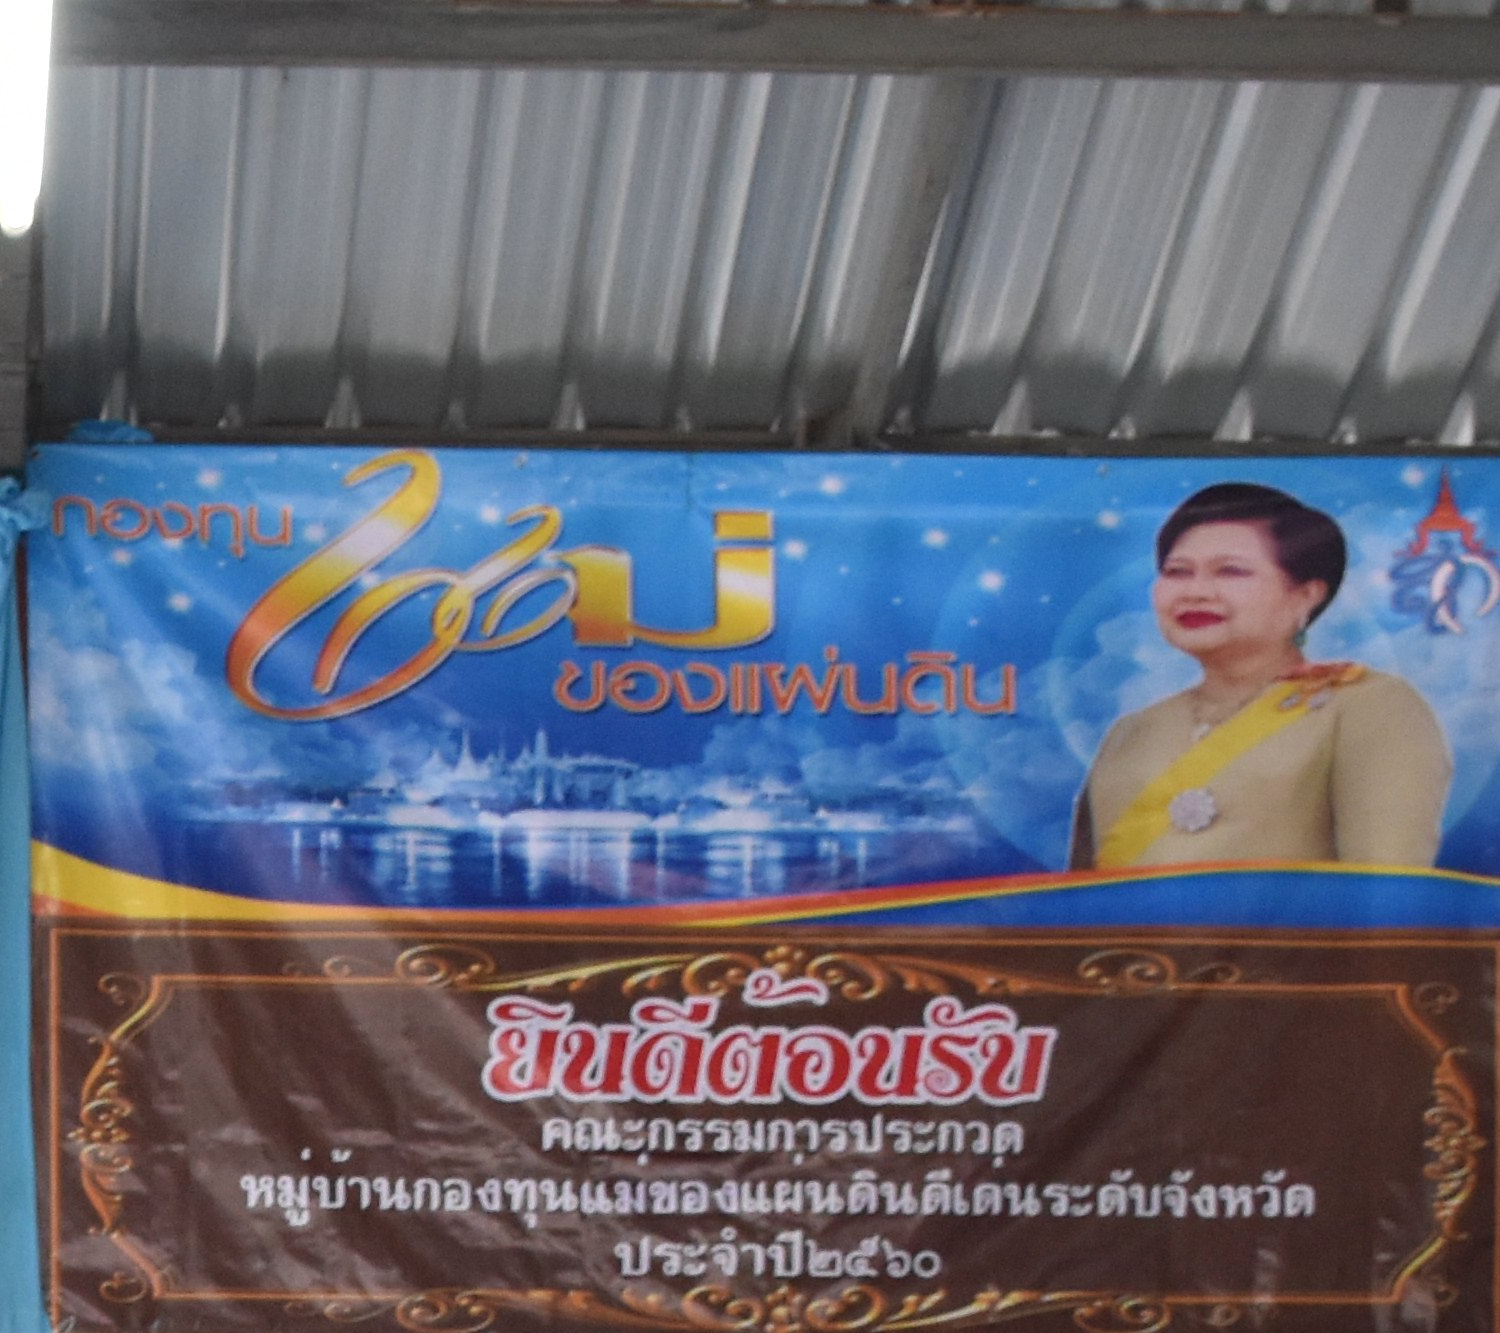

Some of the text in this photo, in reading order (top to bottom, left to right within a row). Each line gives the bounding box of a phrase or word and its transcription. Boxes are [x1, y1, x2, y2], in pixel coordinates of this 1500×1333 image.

[52, 494, 293, 558] กองทุน
[552, 645, 1020, 718] ของแผ่นดิน
[482, 970, 1058, 1108] ยินดีต้อนรับ
[540, 1110, 1025, 1160] คณะกรรมการประกวด
[240, 1155, 1318, 1228] หมู่บ้านกองทุนแม่ของแผ่นดินดีเด่นระดับจังหวัด
[615, 1232, 942, 1285] ประจำปี๒๕๖๐
